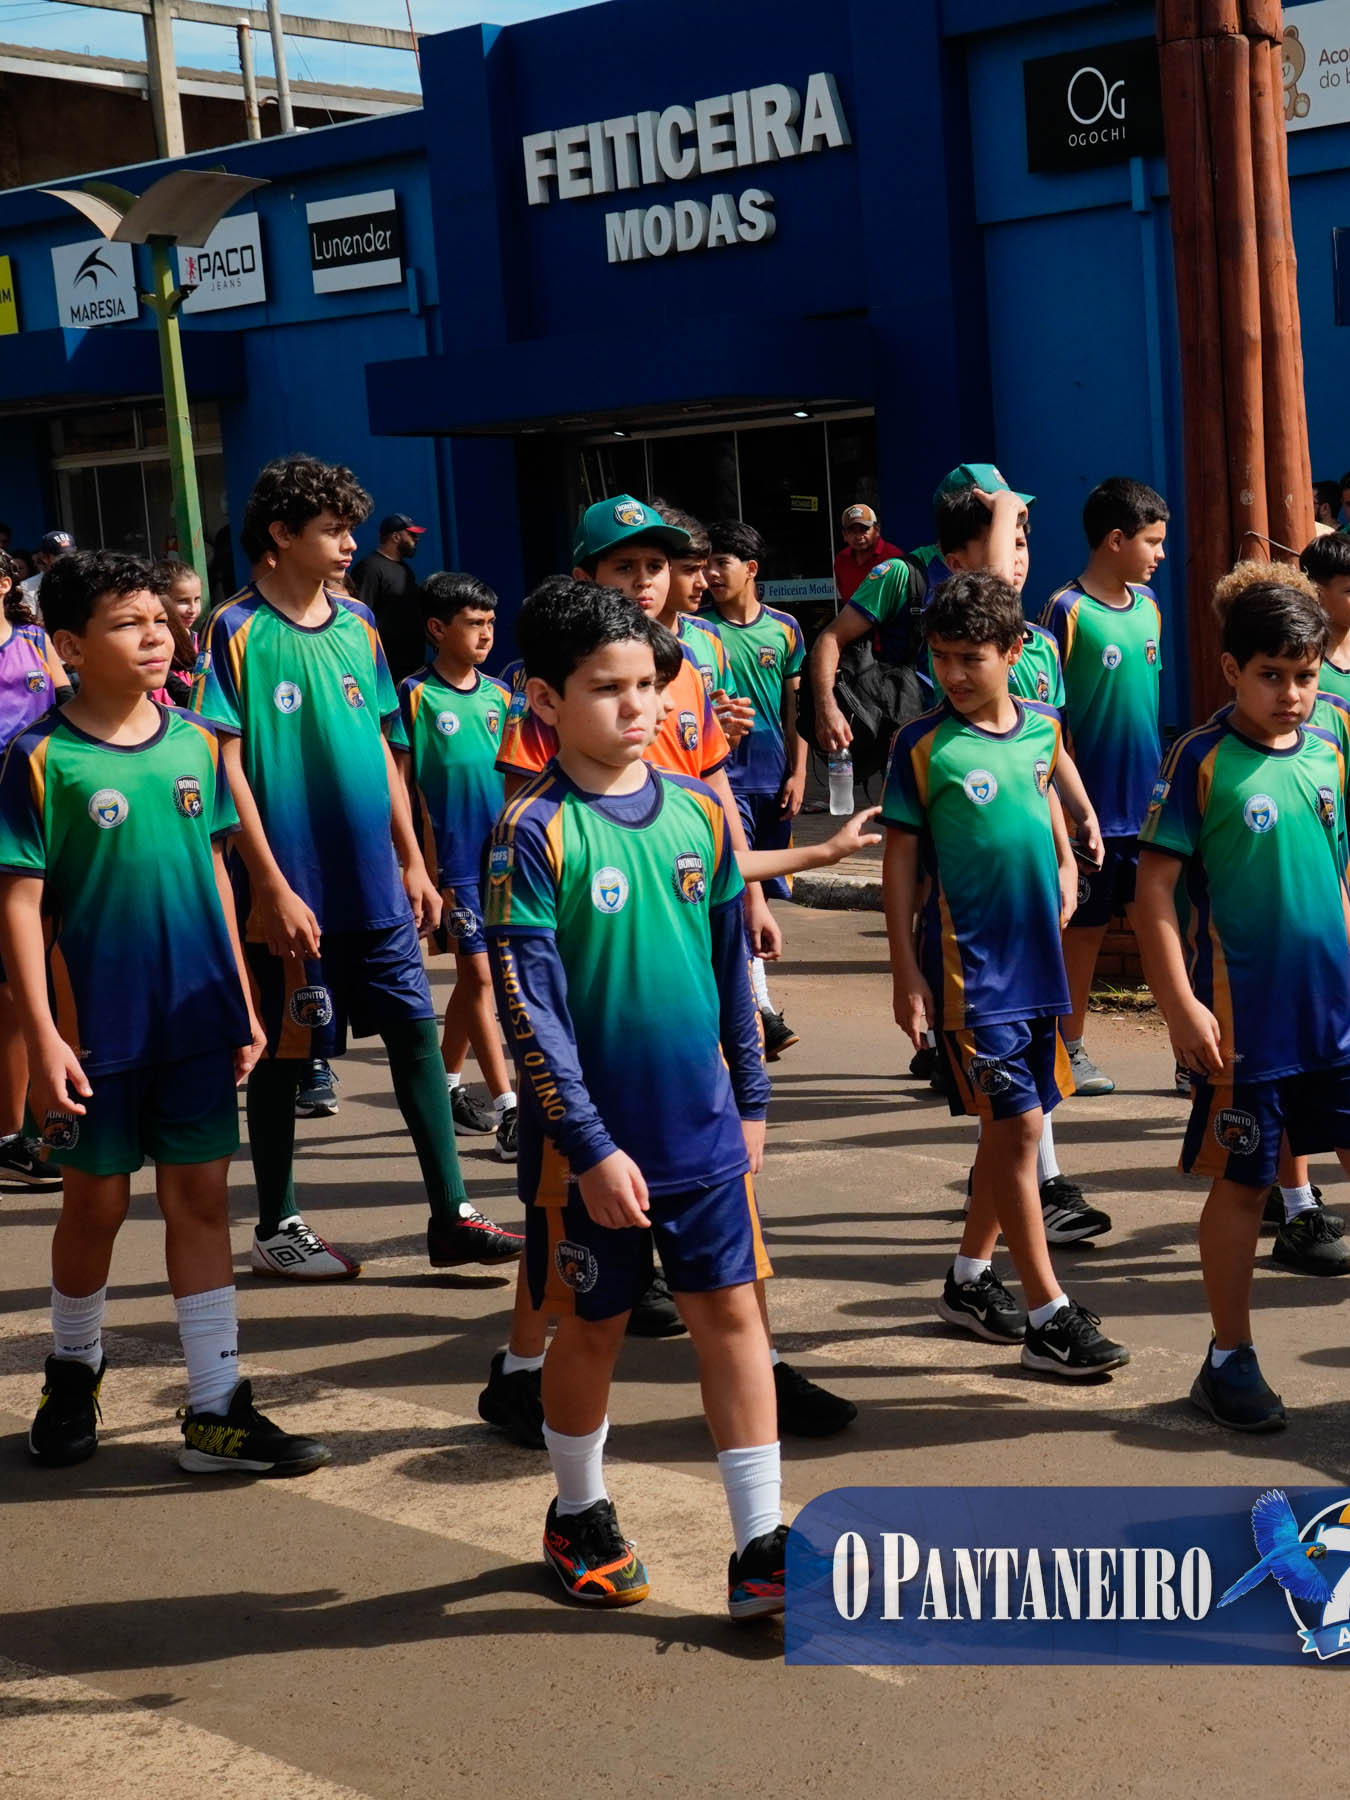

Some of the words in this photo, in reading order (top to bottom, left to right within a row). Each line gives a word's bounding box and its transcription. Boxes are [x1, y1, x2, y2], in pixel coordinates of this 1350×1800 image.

[1318, 71, 1341, 90] do
[522, 72, 852, 206] FEITICEIRA
[1068, 126, 1126, 148] OGOCHI
[605, 188, 777, 264] MODAS
[311, 224, 393, 261] Lunender
[197, 244, 256, 283] PACO
[210, 277, 243, 293] JEANS
[0, 286, 12, 305] M
[70, 298, 127, 325] MARESIA
[177, 778, 200, 790] BONITO
[676, 856, 702, 871] BONITO
[296, 990, 325, 1001] BONITO
[1222, 1111, 1251, 1128] BONITO
[560, 1245, 585, 1262] BONITO
